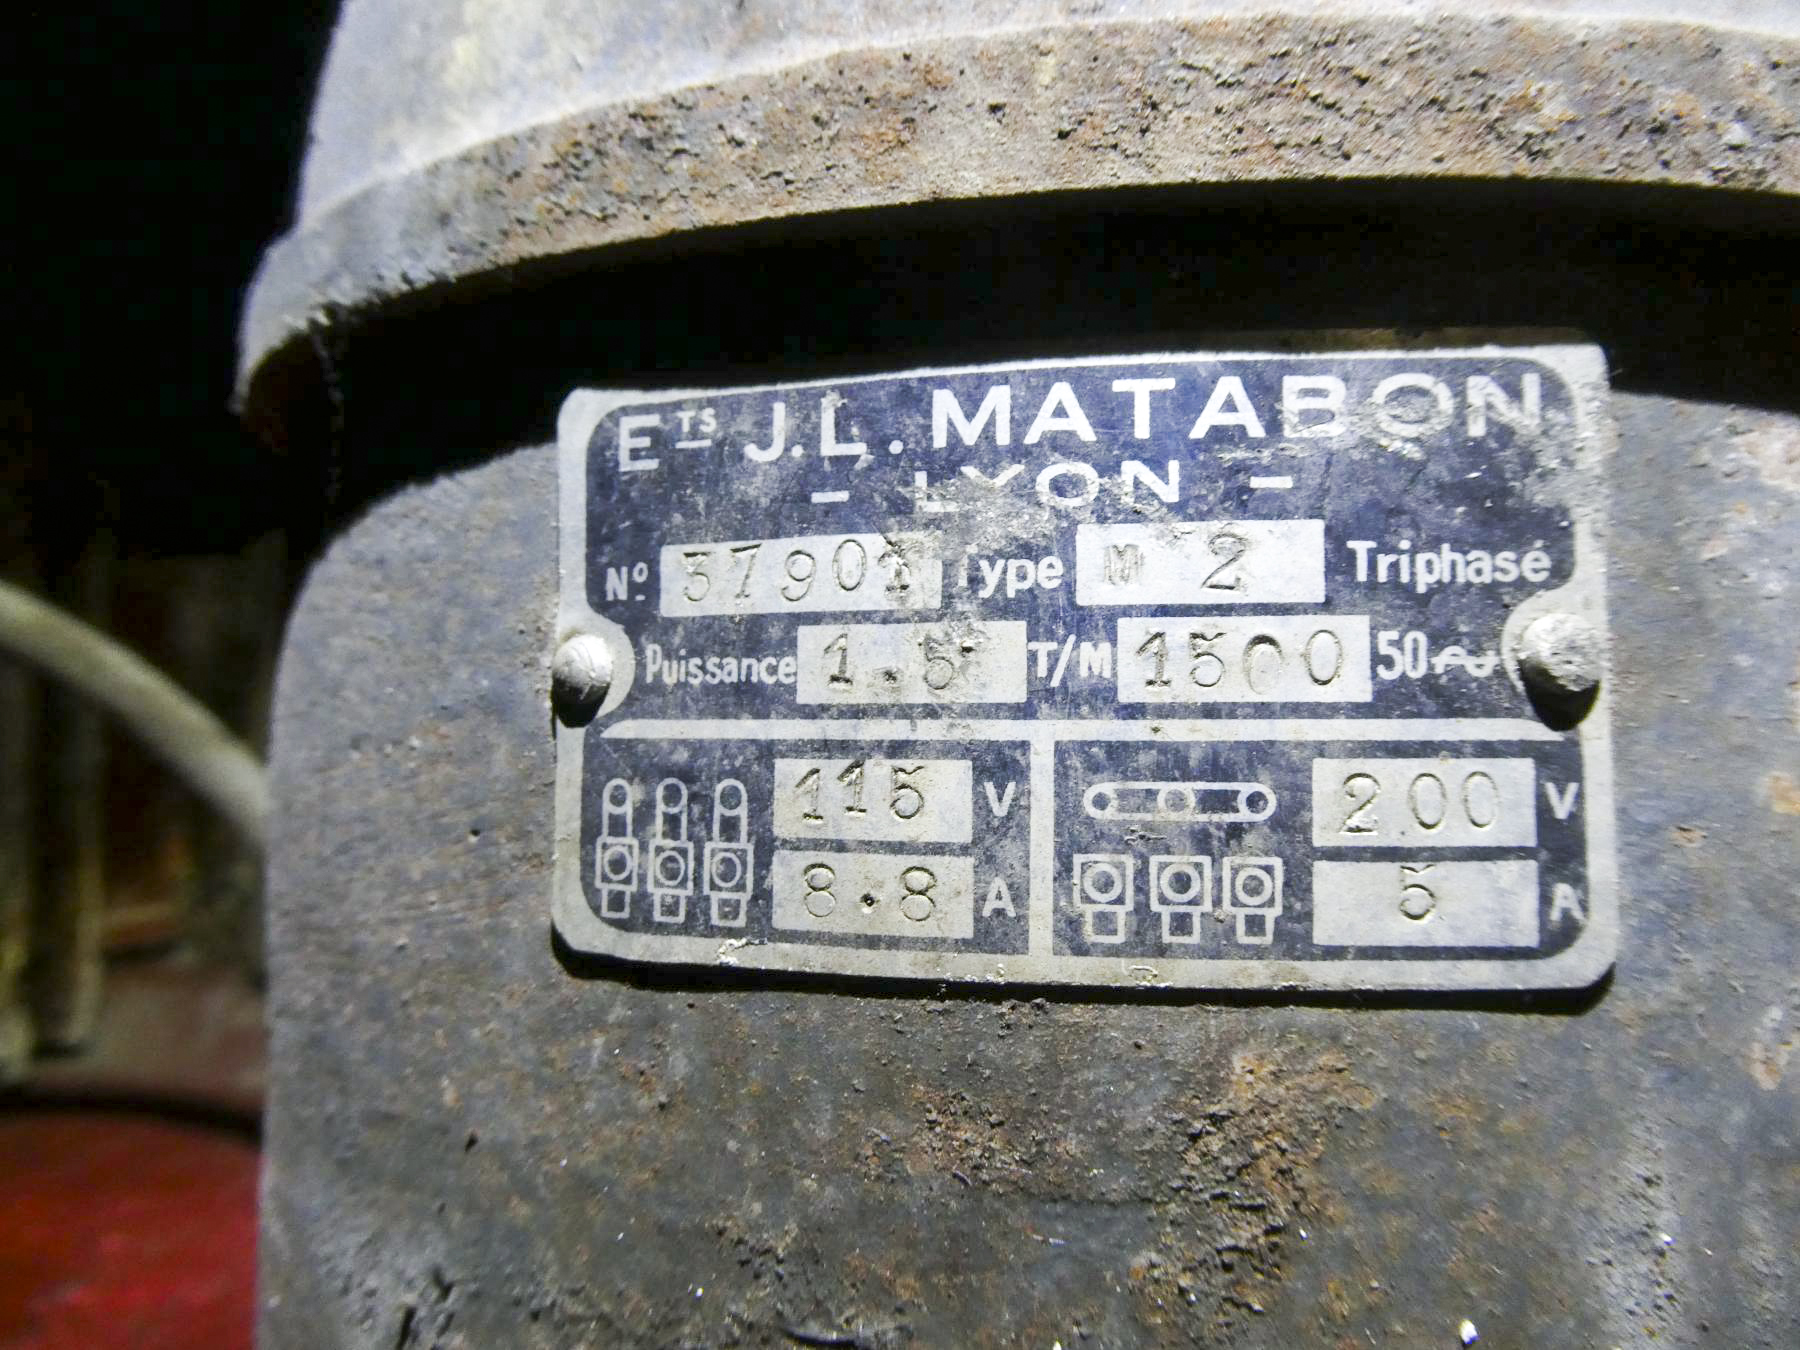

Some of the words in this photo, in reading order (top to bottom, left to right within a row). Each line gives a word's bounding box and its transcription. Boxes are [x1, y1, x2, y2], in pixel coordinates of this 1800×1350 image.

[932, 373, 1541, 447] MATABON
[914, 459, 1180, 513] LYON
[1201, 532, 1248, 592] 2
[1346, 539, 1552, 594] Triphasé
[645, 643, 797, 686] Puissance
[1027, 634, 1116, 689] T/M
[1135, 628, 1344, 694] 1500
[1376, 630, 1428, 681] 50
[794, 758, 925, 822] 115
[984, 781, 1017, 817] V
[1338, 770, 1500, 836] 200
[1544, 782, 1579, 820] V
[982, 878, 1017, 917] A
[1399, 864, 1437, 922] 5
[1551, 882, 1586, 922] A
